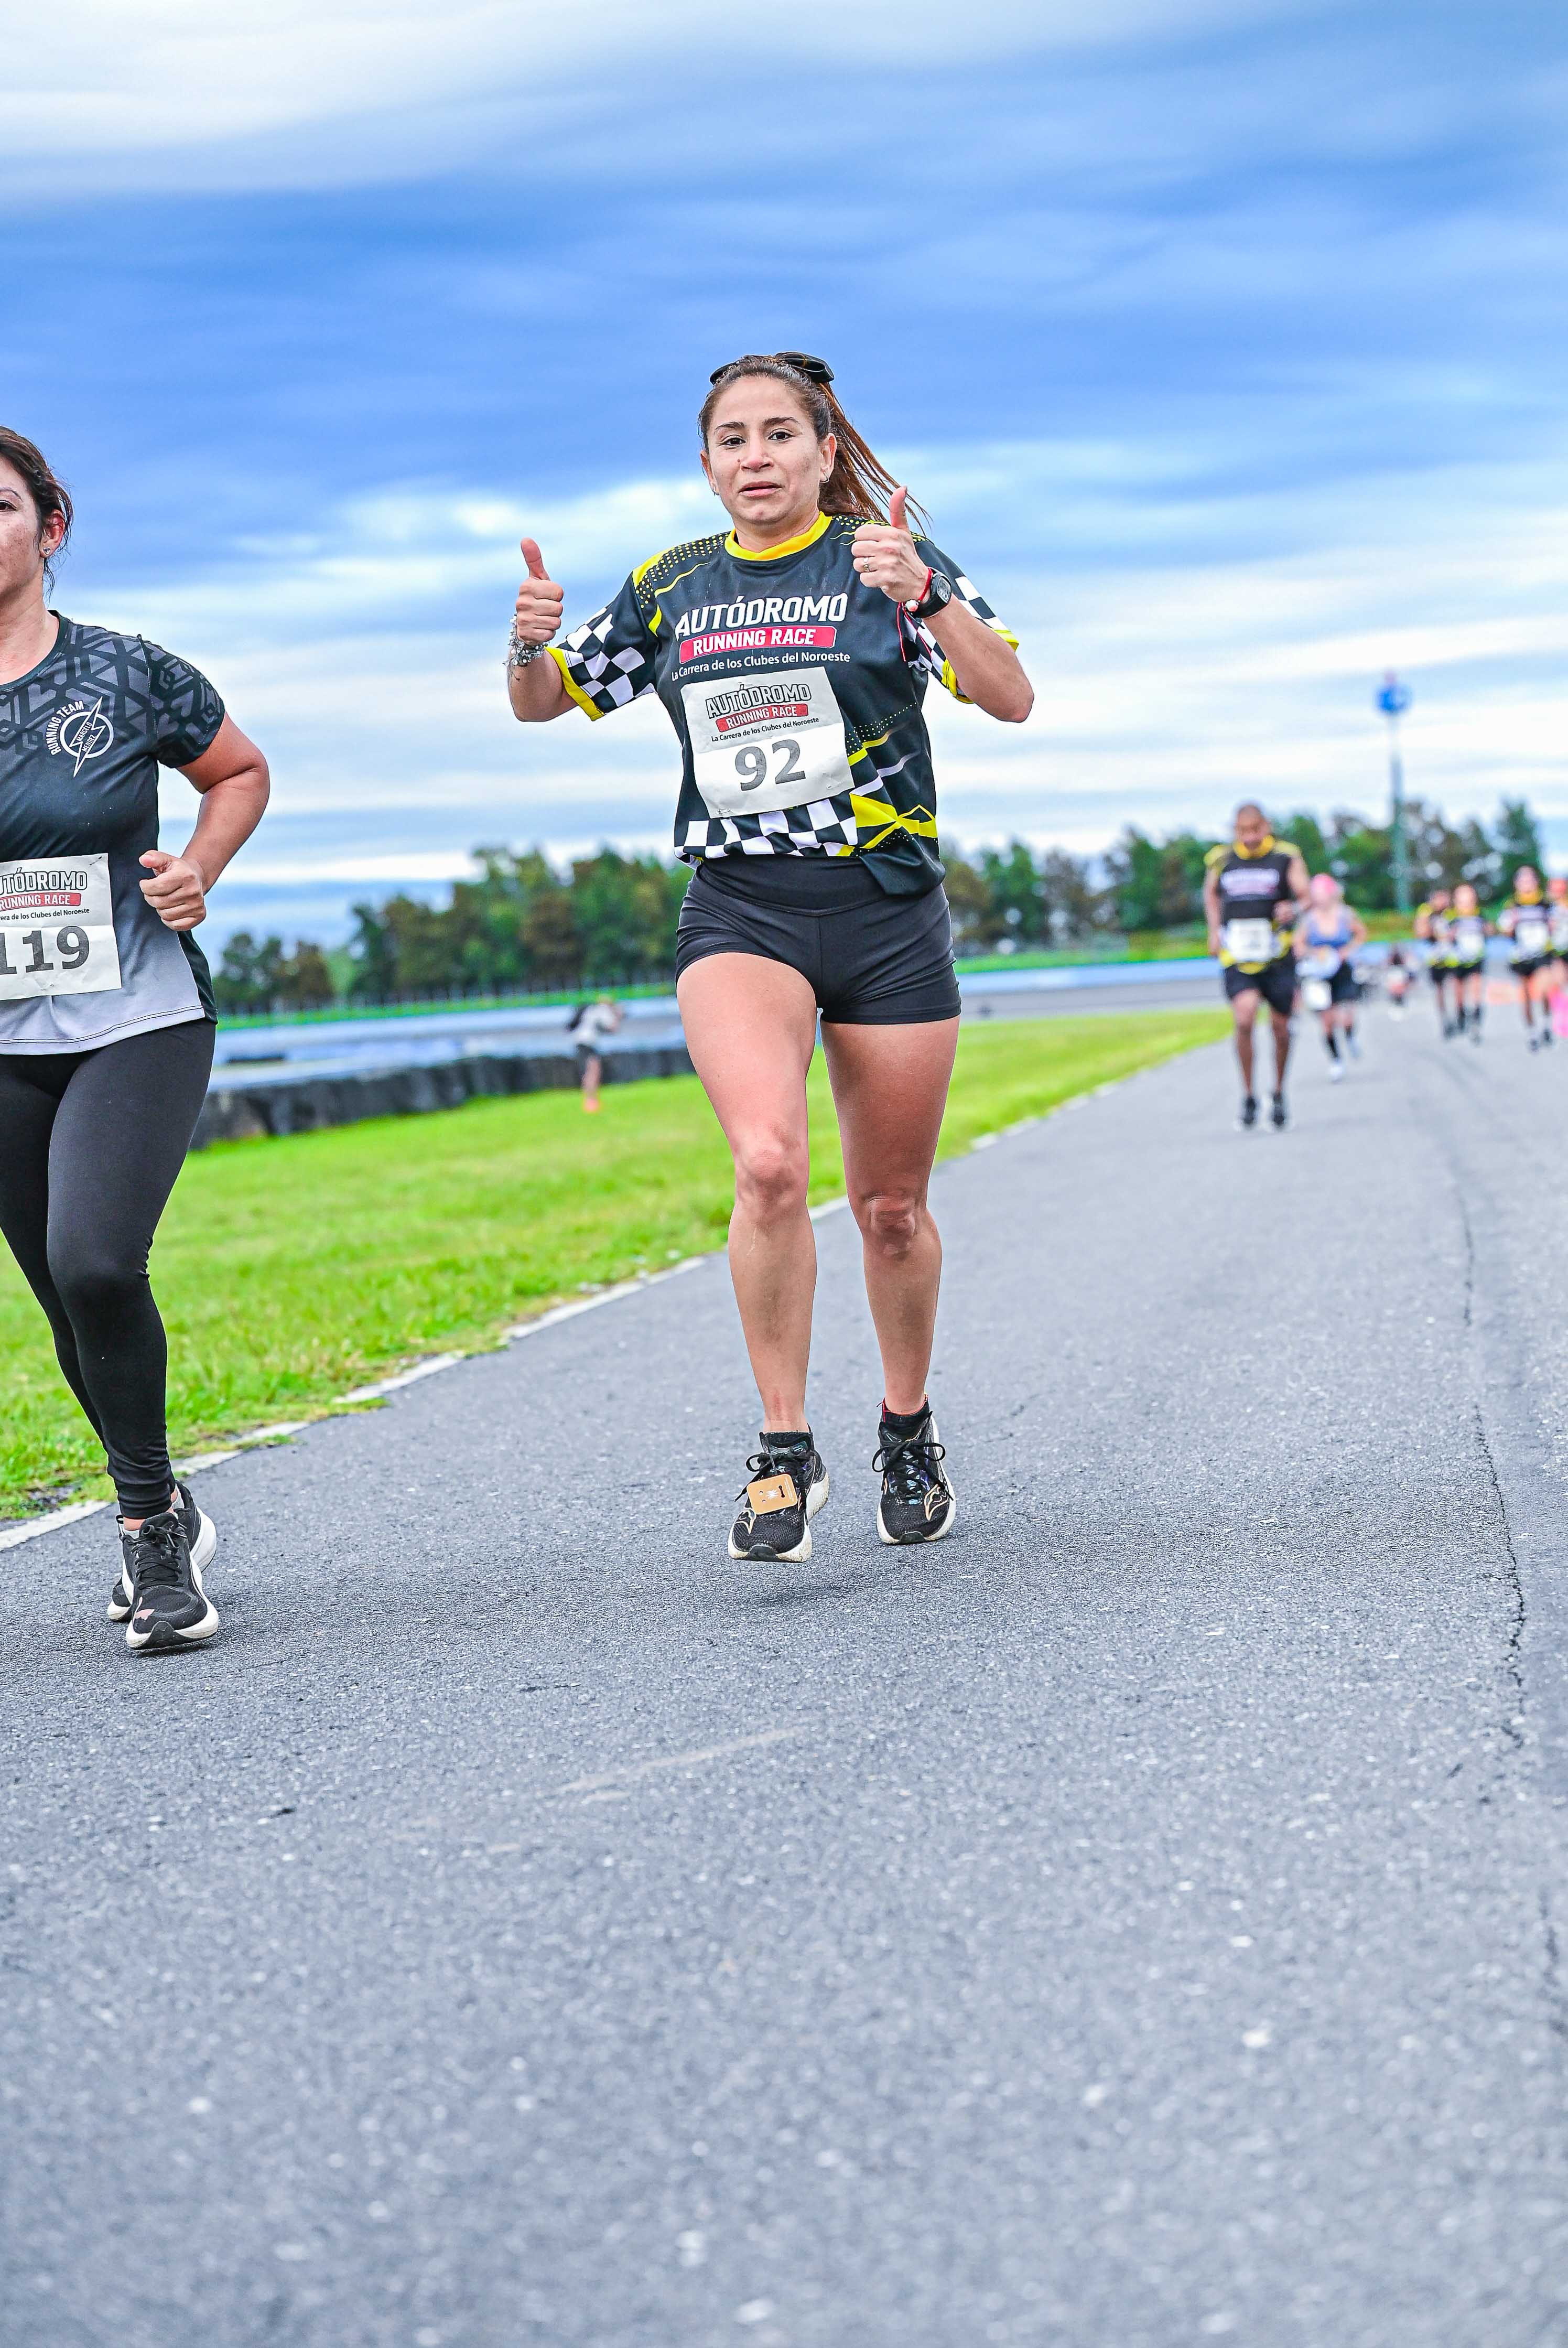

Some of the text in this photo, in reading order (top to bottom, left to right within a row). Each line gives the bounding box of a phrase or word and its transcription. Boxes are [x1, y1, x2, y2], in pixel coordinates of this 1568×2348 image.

[675, 593, 848, 642] AUTÓDROMO
[693, 629, 816, 656] RUNNING RACE
[672, 652, 850, 681] La Carrera de los Clubes del Noroeste
[706, 684, 812, 719] AUTÓDROMO
[46, 701, 84, 755] RUNNING TEAM
[719, 731, 742, 740] Carrera
[762, 724, 782, 732] Clubes
[793, 717, 819, 726] Noroeste
[726, 706, 797, 728] RUNNING RACE
[76, 721, 93, 742] MARCELO
[82, 734, 96, 752] MENDEZ
[735, 739, 805, 791] 92
[44, 895, 70, 905] RACE
[0, 926, 90, 974] 119
